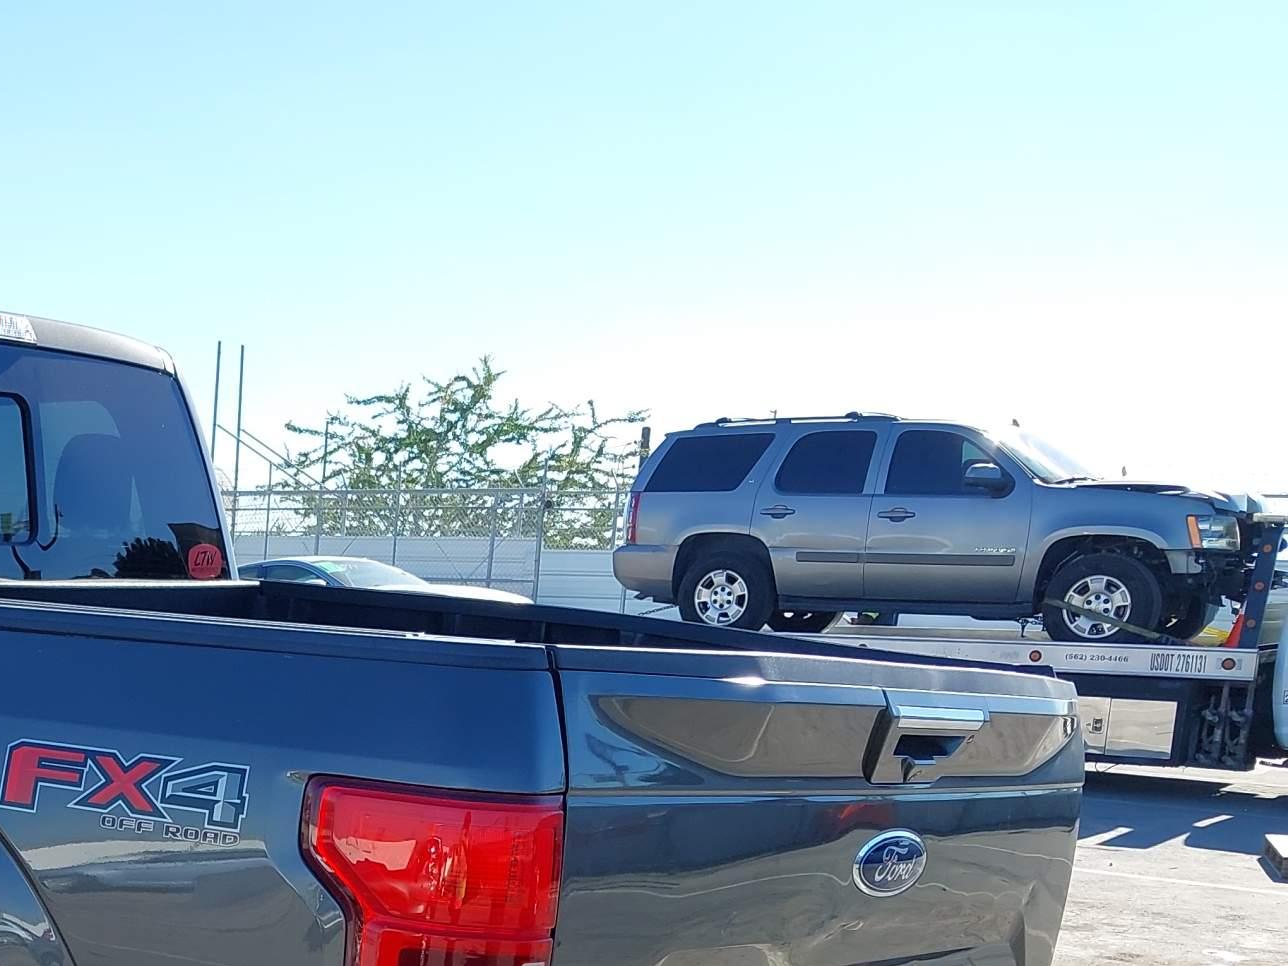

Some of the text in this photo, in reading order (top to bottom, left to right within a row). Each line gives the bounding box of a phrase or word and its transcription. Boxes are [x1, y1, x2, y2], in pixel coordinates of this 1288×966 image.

[1065, 653, 1130, 664] (562) 230-4466
[1149, 652, 1209, 674] USDOT 2761131
[99, 815, 241, 848] OFF ROAD
[874, 845, 917, 882] Ford
